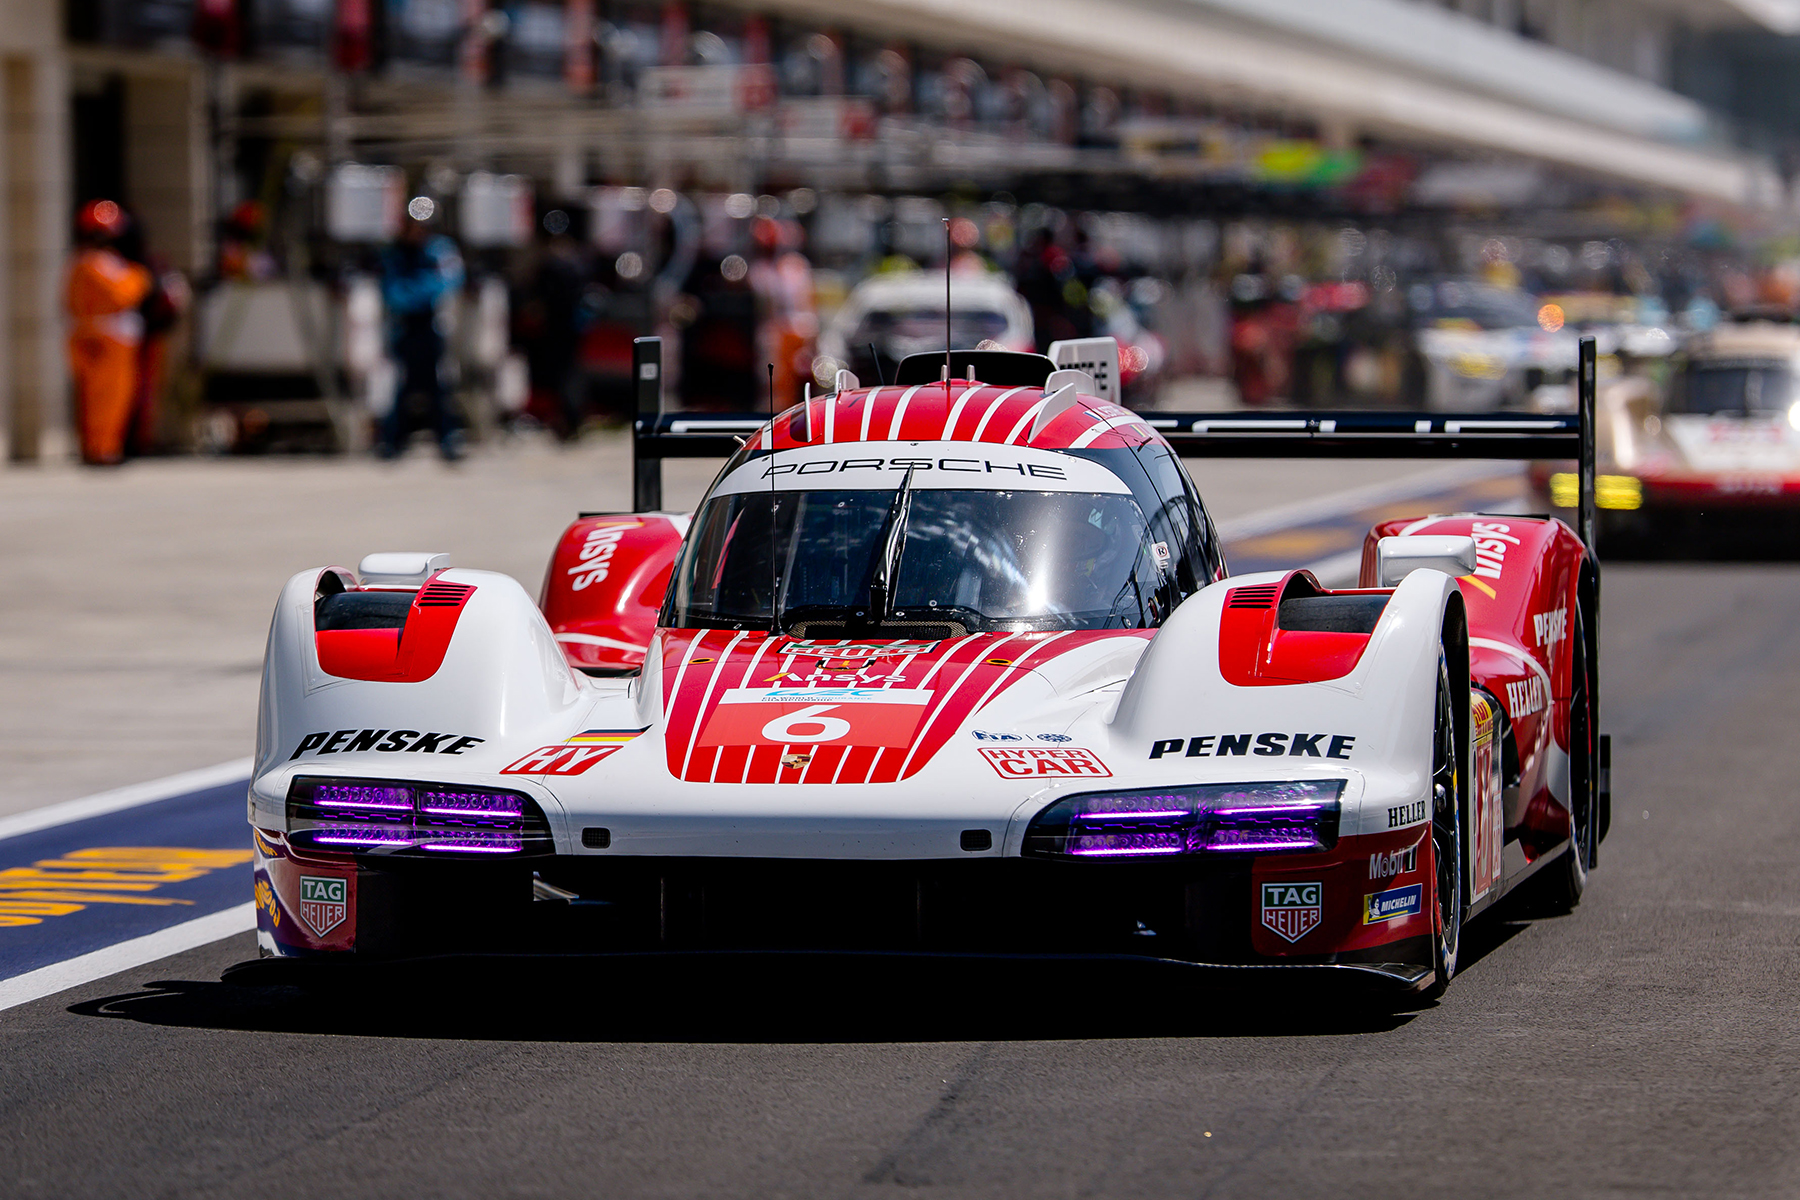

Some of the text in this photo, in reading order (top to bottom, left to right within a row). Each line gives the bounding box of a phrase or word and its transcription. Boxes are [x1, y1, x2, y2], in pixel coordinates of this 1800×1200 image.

[761, 458, 1067, 480] PORSCHE
[763, 672, 907, 684] Ansys
[762, 704, 851, 742] 6
[289, 729, 486, 761] PENSKE
[987, 750, 1088, 759] HYPER
[1149, 733, 1356, 760] PENSKE
[506, 747, 613, 772] HY
[999, 759, 1102, 775] CAR
[1388, 800, 1426, 828] HELLER
[1369, 848, 1405, 880] Mobil
[304, 881, 341, 900] TAG
[1267, 887, 1317, 905] TAG
[1381, 895, 1417, 912] MICHELIN
[302, 903, 342, 932] HEUER
[1266, 910, 1318, 938] HEUER
